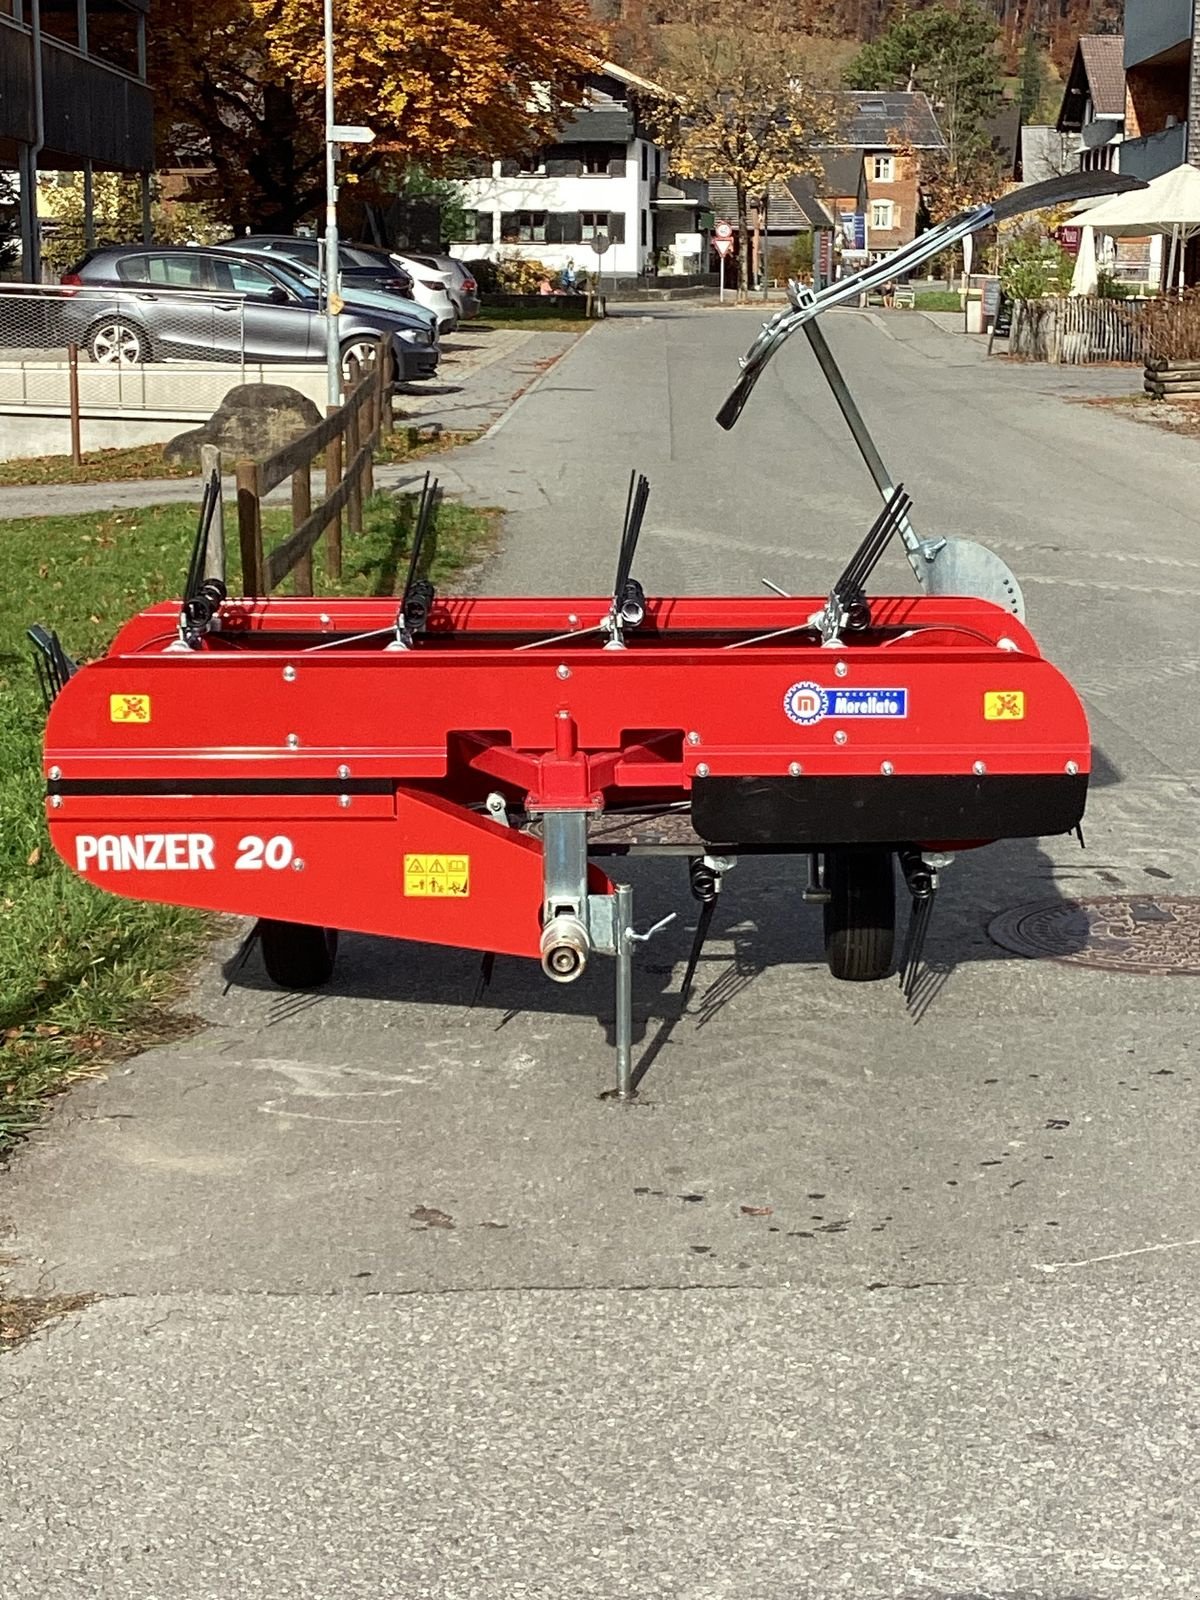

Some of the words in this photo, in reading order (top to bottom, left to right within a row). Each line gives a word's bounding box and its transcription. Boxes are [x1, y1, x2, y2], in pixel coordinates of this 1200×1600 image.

[834, 697, 898, 714] Morellato
[75, 833, 215, 871] PANZER
[234, 835, 293, 870] 20
